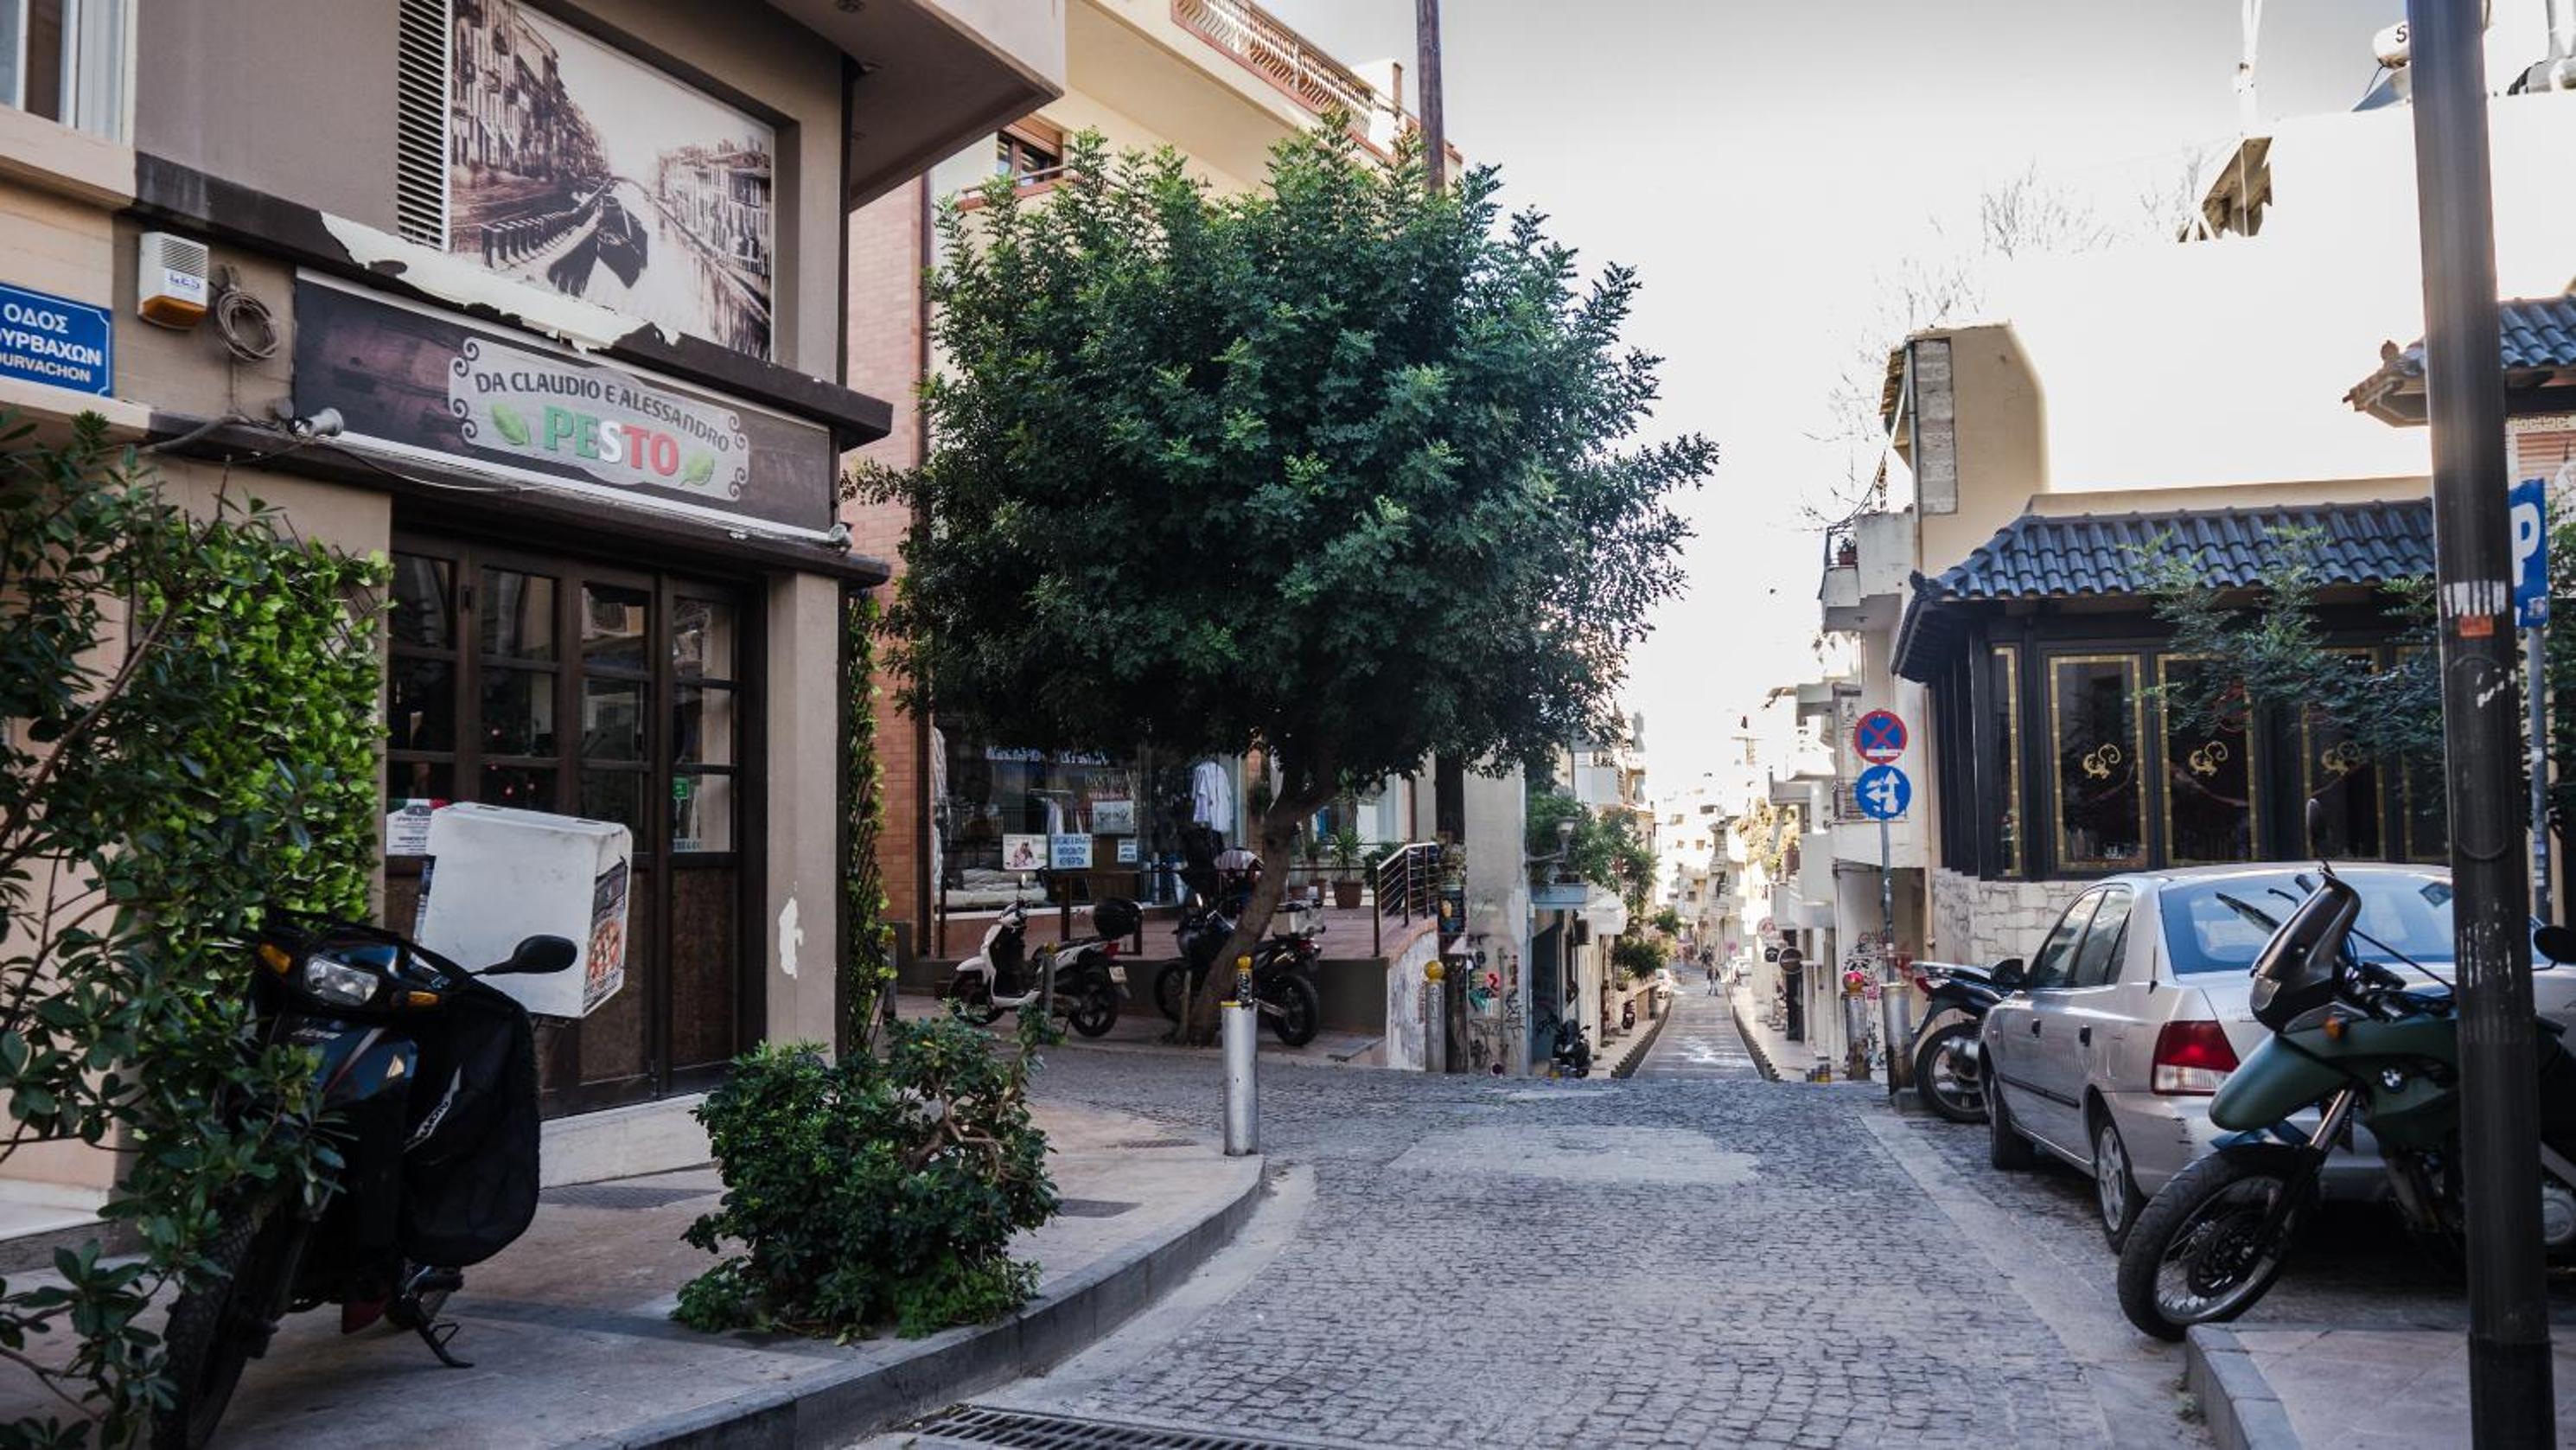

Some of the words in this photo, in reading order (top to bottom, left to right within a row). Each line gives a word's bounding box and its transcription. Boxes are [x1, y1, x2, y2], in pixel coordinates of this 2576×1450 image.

[3, 303, 69, 334] ΟΔΟΣ
[0, 328, 102, 367] ΥΡΒΑΧΩΝ
[0, 352, 91, 383] URVACHON
[475, 373, 507, 394] DA
[512, 372, 601, 399] CLAUDIO
[605, 384, 616, 405] E
[619, 388, 730, 453] ALESSANDRO
[545, 406, 680, 477] PESTO
[2510, 502, 2541, 587] P
